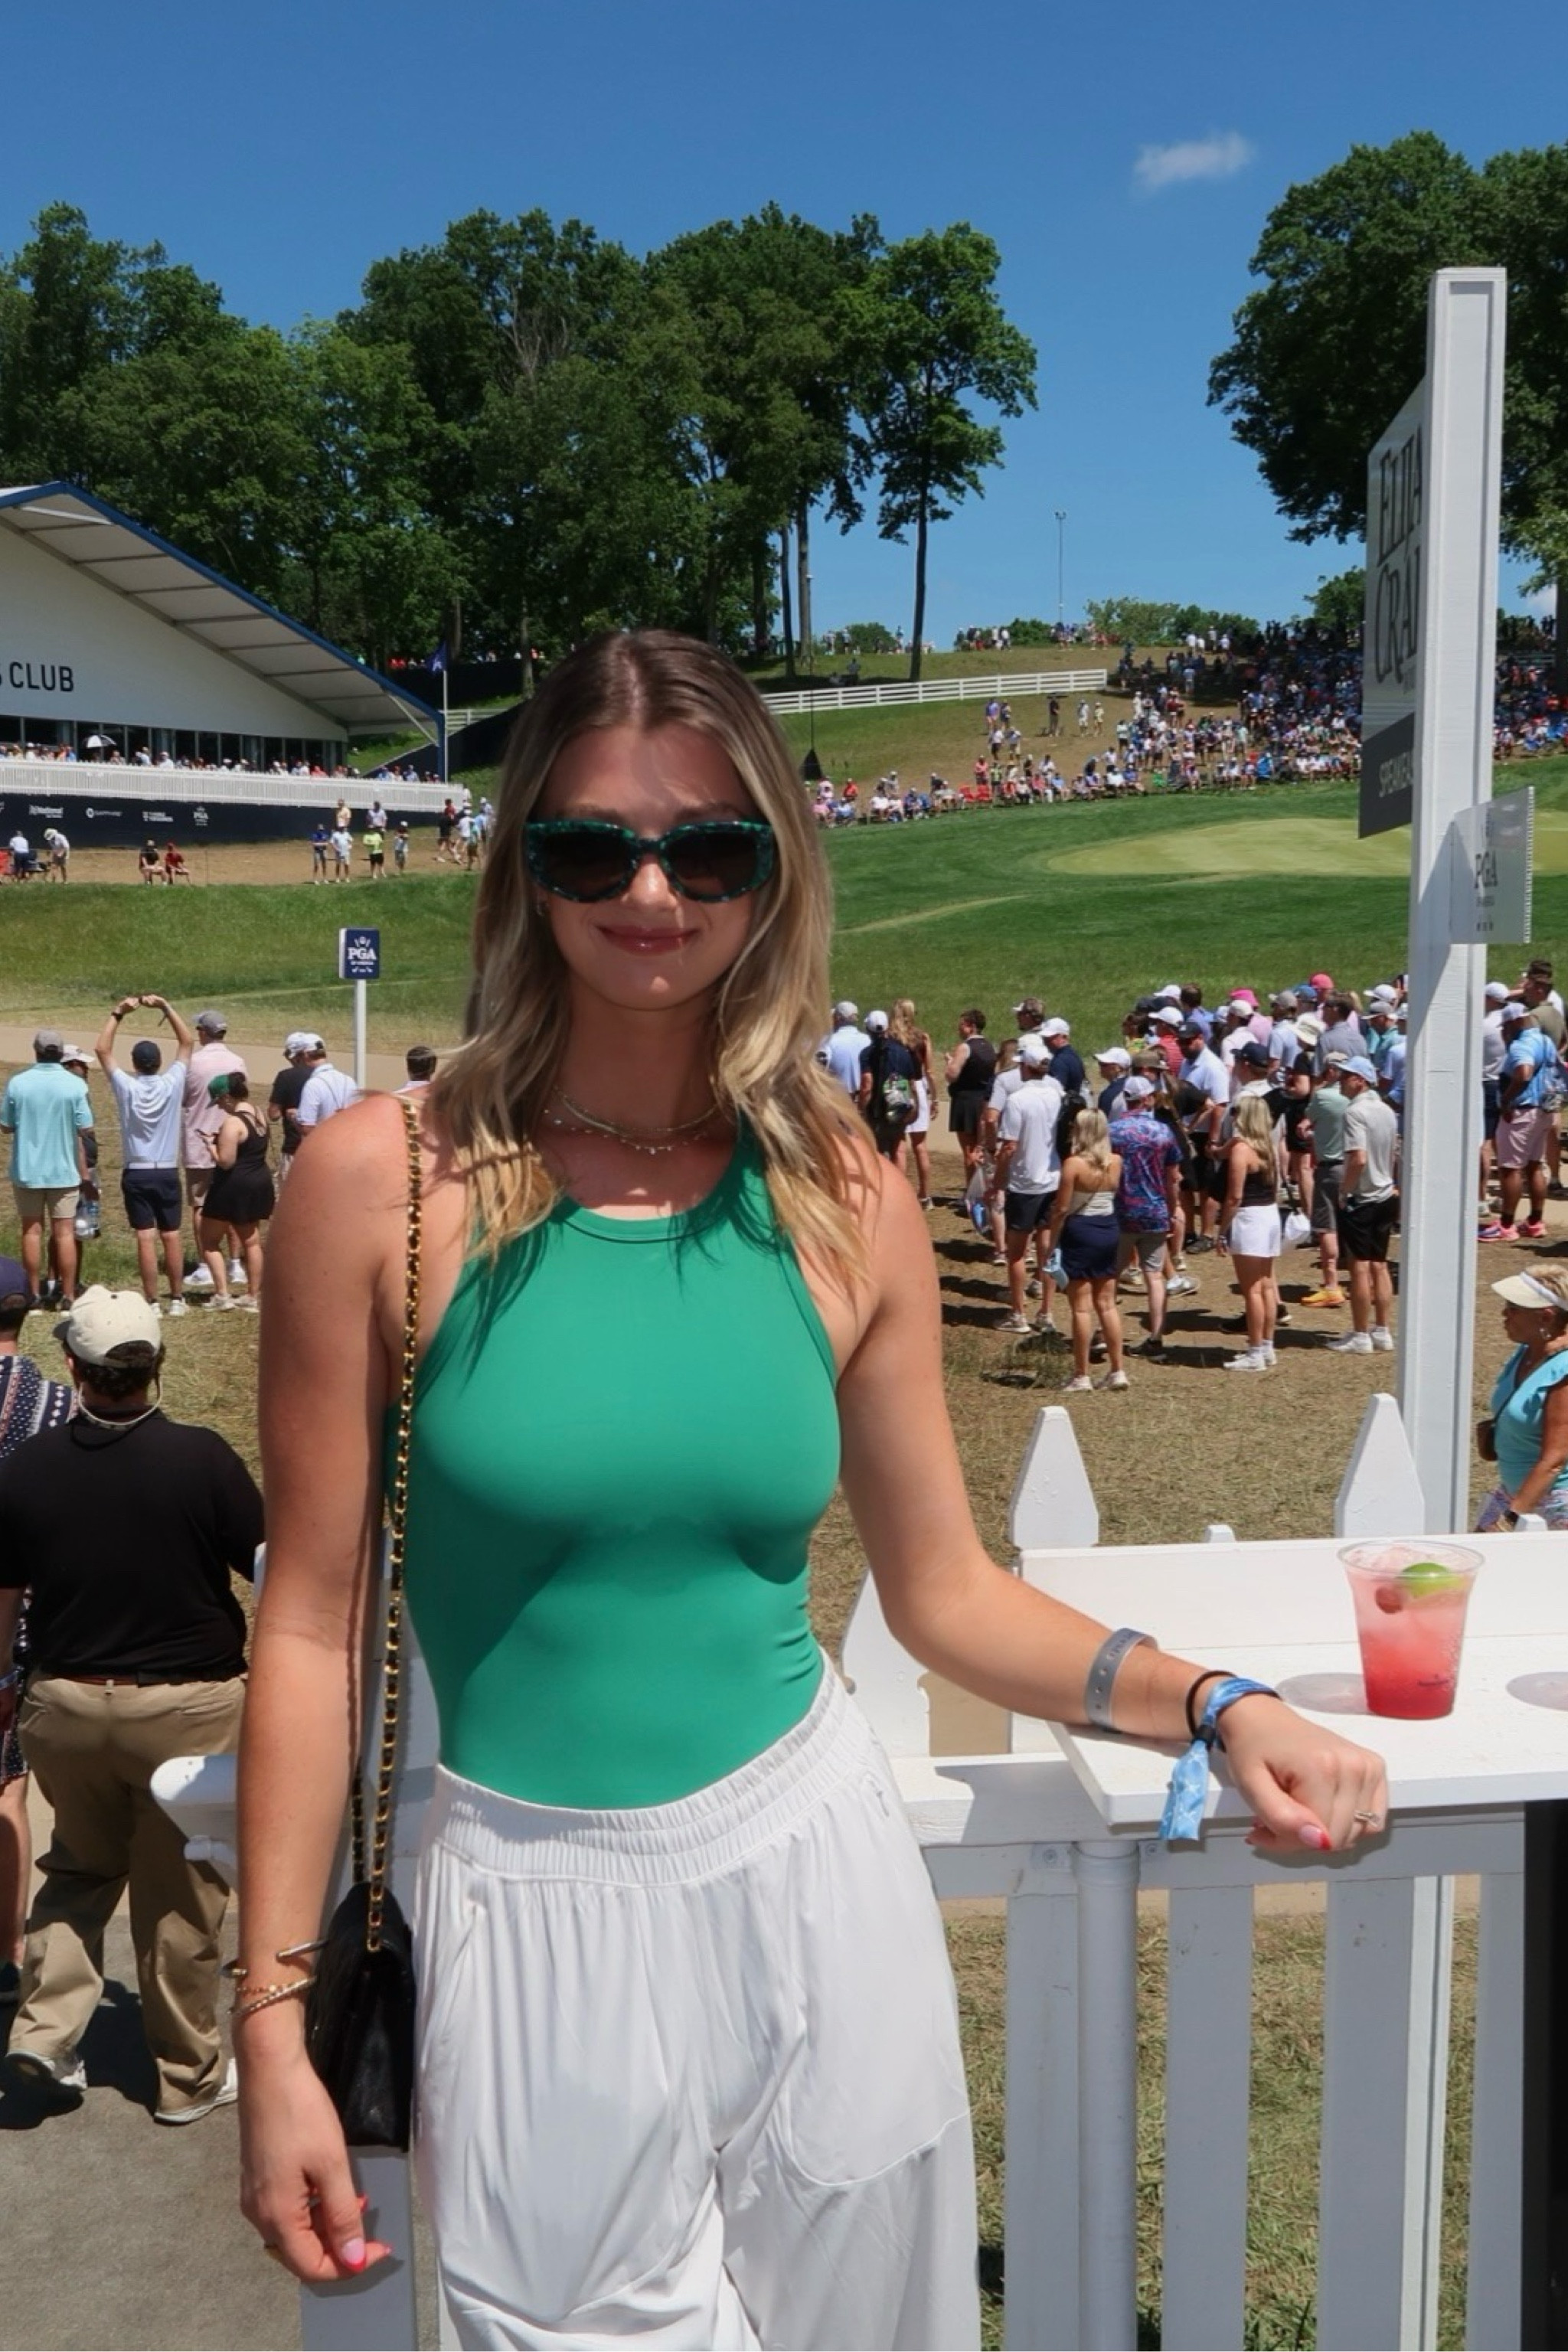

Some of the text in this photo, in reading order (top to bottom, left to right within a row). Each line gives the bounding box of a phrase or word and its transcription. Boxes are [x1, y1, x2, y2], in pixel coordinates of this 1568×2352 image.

[9, 661, 74, 692] CLUB
[1475, 850, 1498, 889] PGA
[348, 947, 377, 960] PGA
